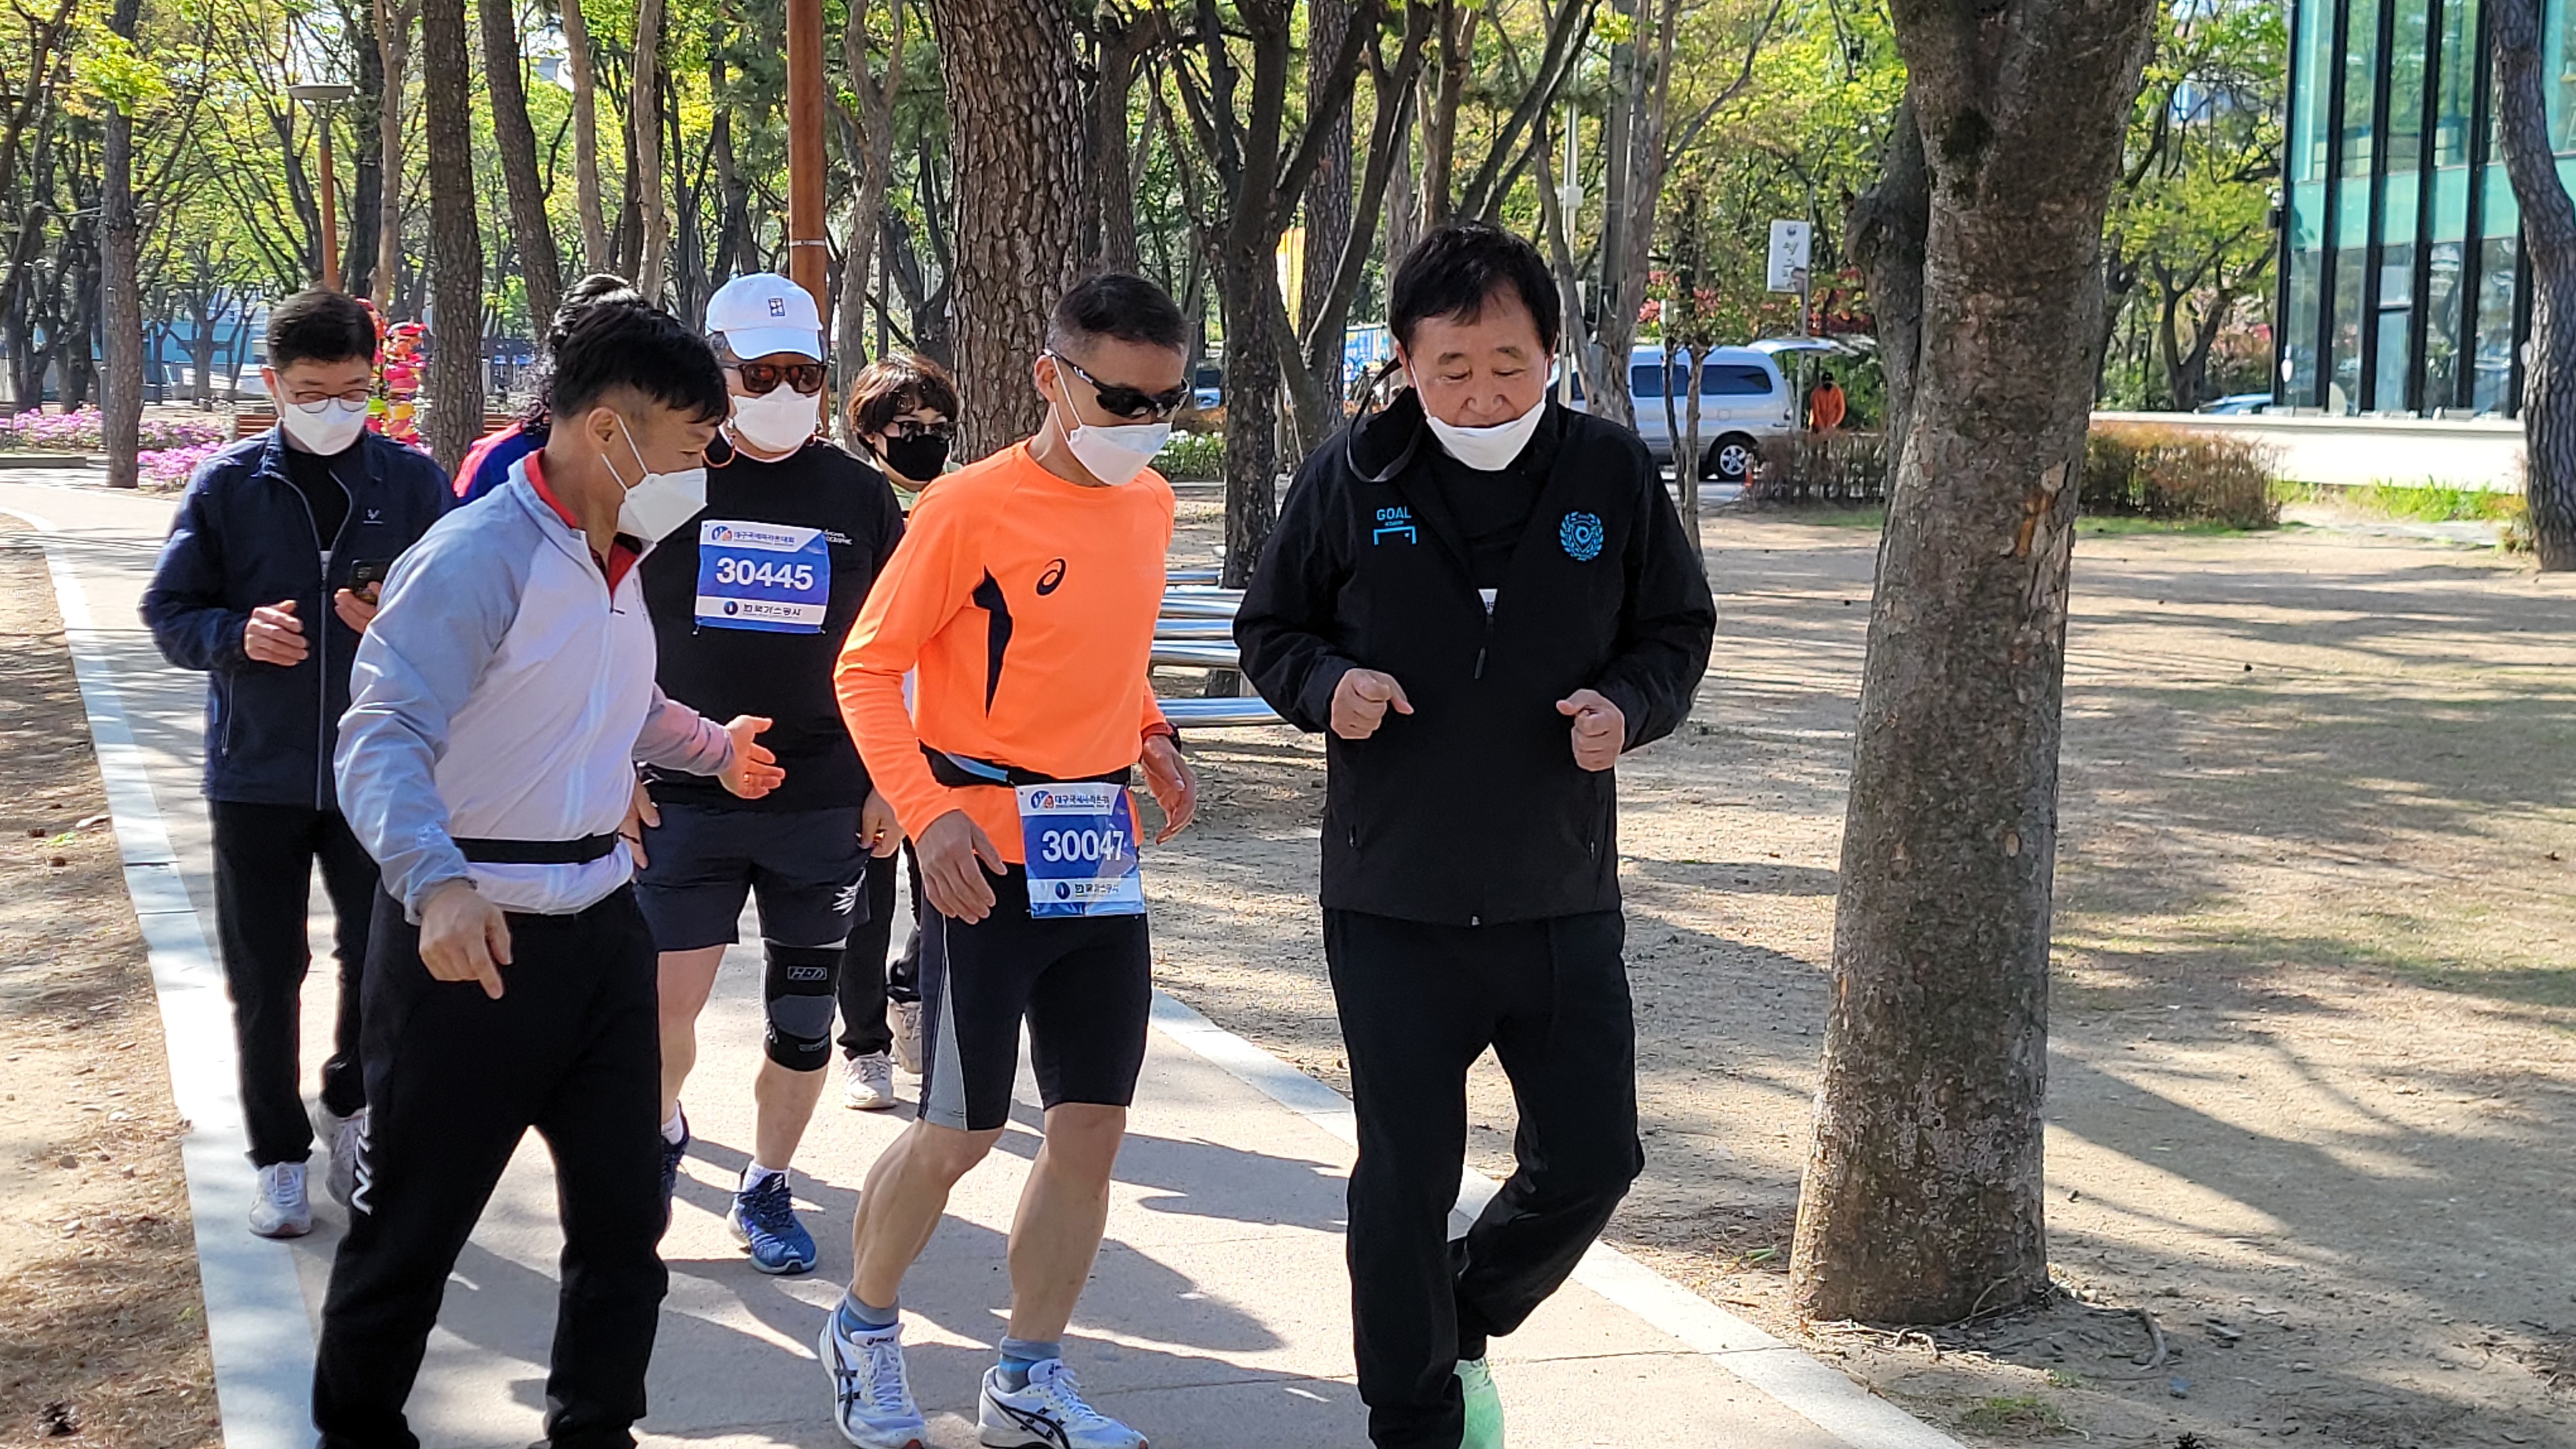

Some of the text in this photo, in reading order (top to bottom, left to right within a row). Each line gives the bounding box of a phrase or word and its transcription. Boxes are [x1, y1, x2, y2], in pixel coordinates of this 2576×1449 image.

[1376, 505, 1412, 521] GOAL
[716, 557, 814, 590] 30445
[1041, 829, 1124, 862] 30047
